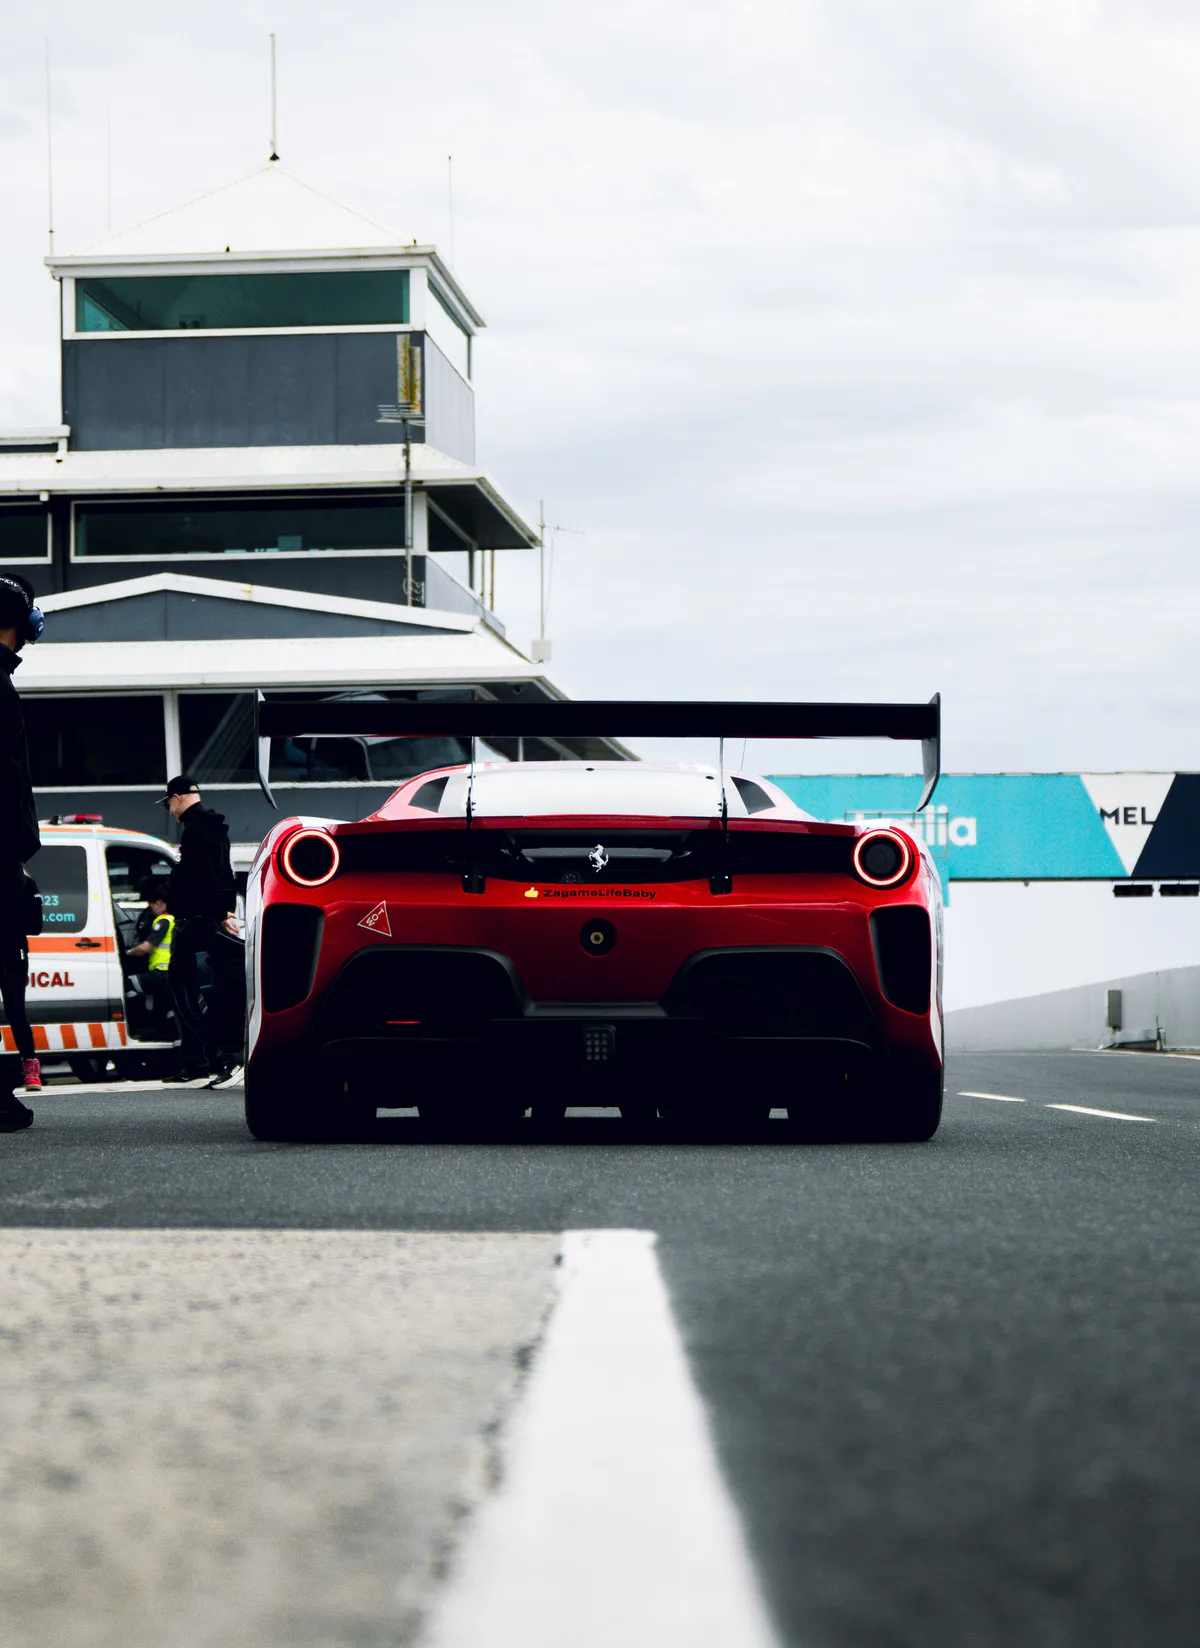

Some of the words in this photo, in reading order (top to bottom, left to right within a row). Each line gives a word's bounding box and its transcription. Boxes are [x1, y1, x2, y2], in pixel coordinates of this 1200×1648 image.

[1099, 806, 1155, 825] MEL
[543, 889, 657, 899] ZagameLifeBaby
[365, 908, 385, 926] TOW
[25, 971, 75, 988] ICAL
